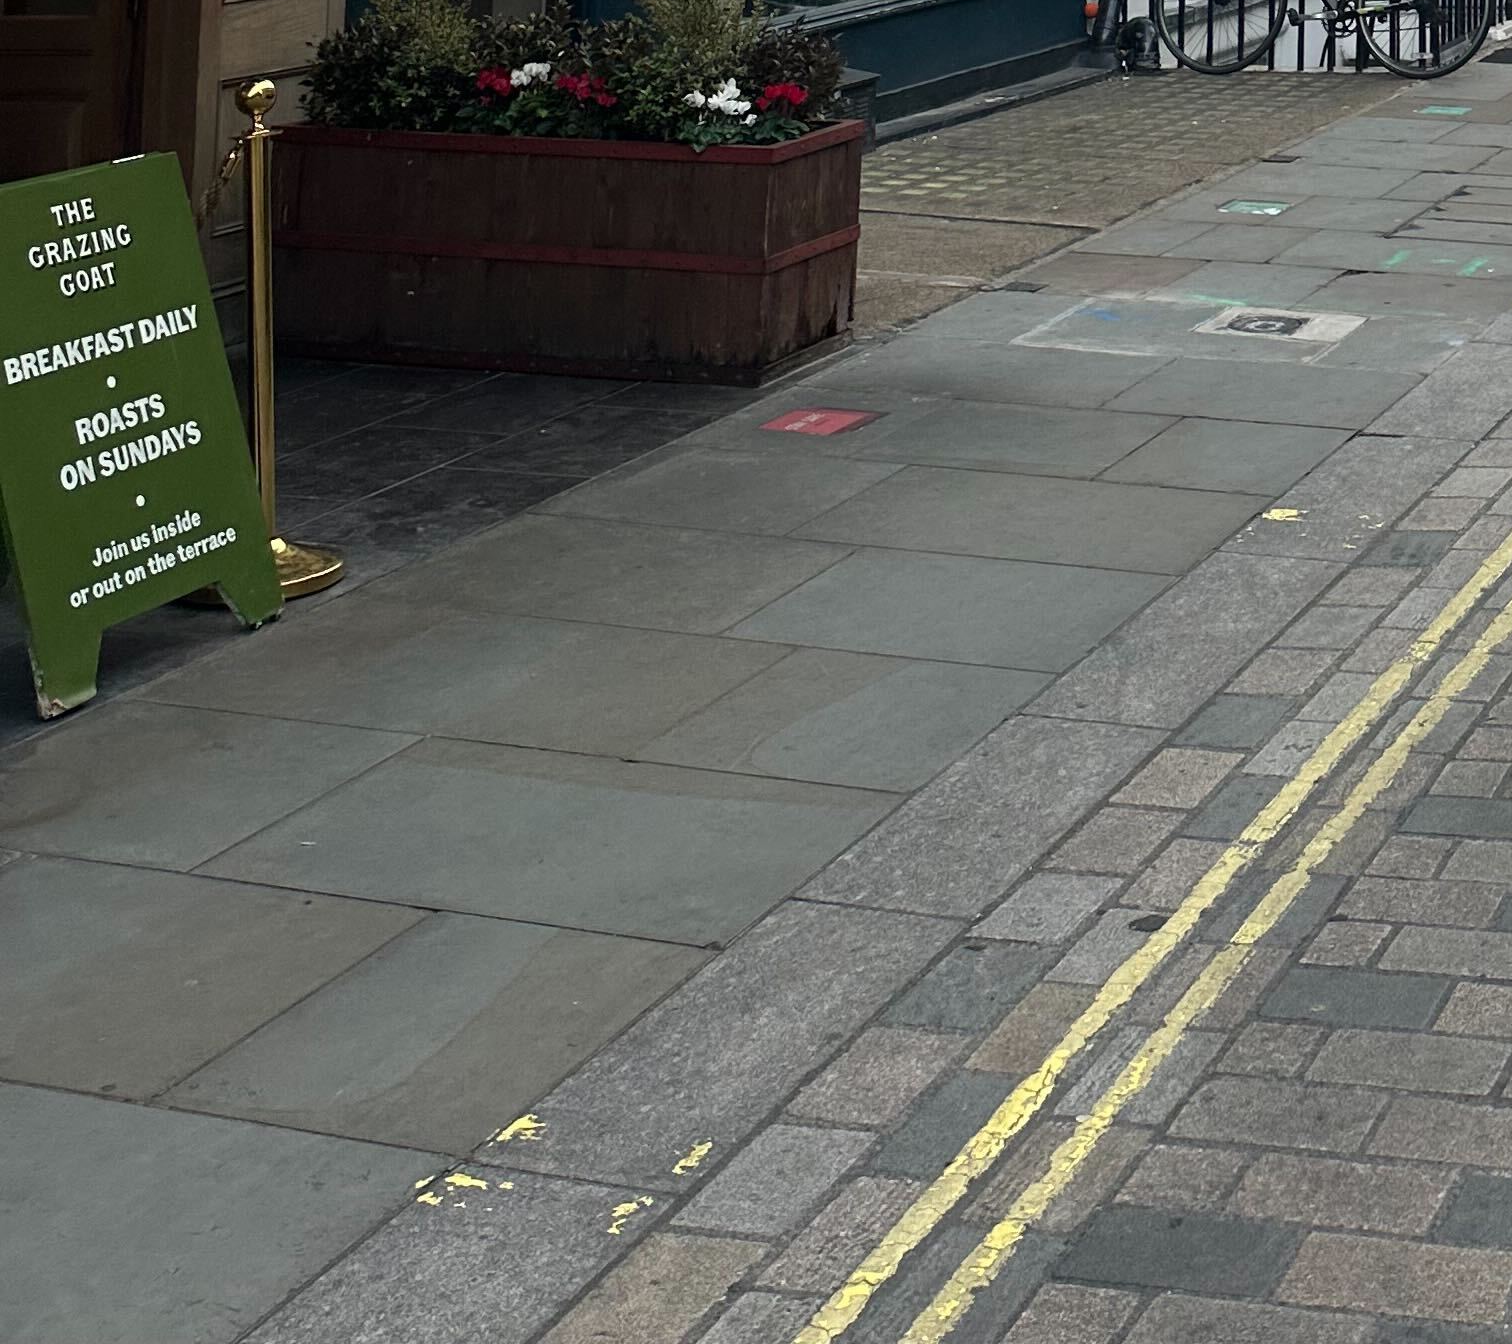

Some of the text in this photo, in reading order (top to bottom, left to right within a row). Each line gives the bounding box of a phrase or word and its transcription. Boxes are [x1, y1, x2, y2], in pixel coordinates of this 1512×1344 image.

[50, 197, 96, 227] THE
[28, 224, 132, 269] GRAZING
[59, 262, 116, 297] GOAT
[4, 304, 198, 385] BREAKFAST DAILY
[74, 393, 166, 445] ROASTS
[60, 420, 202, 491] ON SUNDAYS
[92, 510, 201, 567] Join us inside
[70, 527, 237, 608] or out on the terrace
